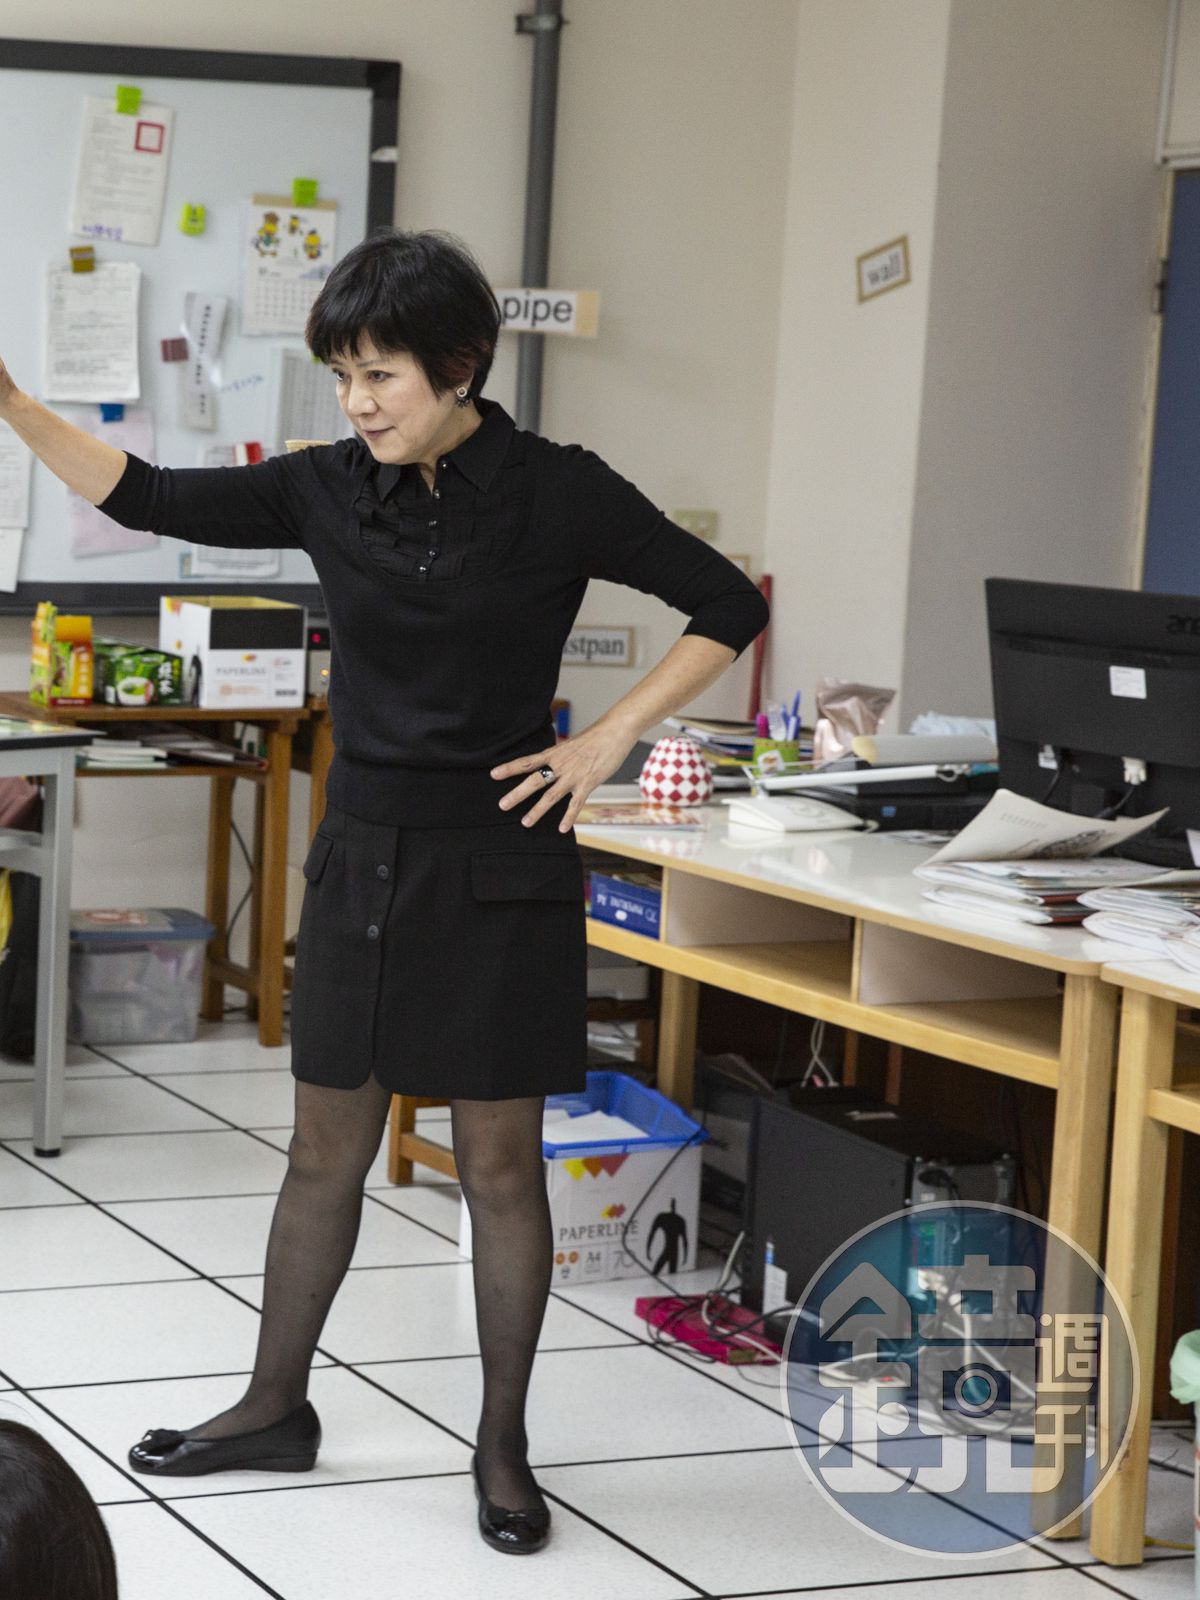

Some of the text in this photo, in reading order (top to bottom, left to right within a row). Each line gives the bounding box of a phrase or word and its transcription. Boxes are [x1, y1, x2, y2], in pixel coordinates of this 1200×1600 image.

[867, 250, 901, 286] wall
[501, 289, 573, 328] pipe
[563, 636, 624, 660] stpan
